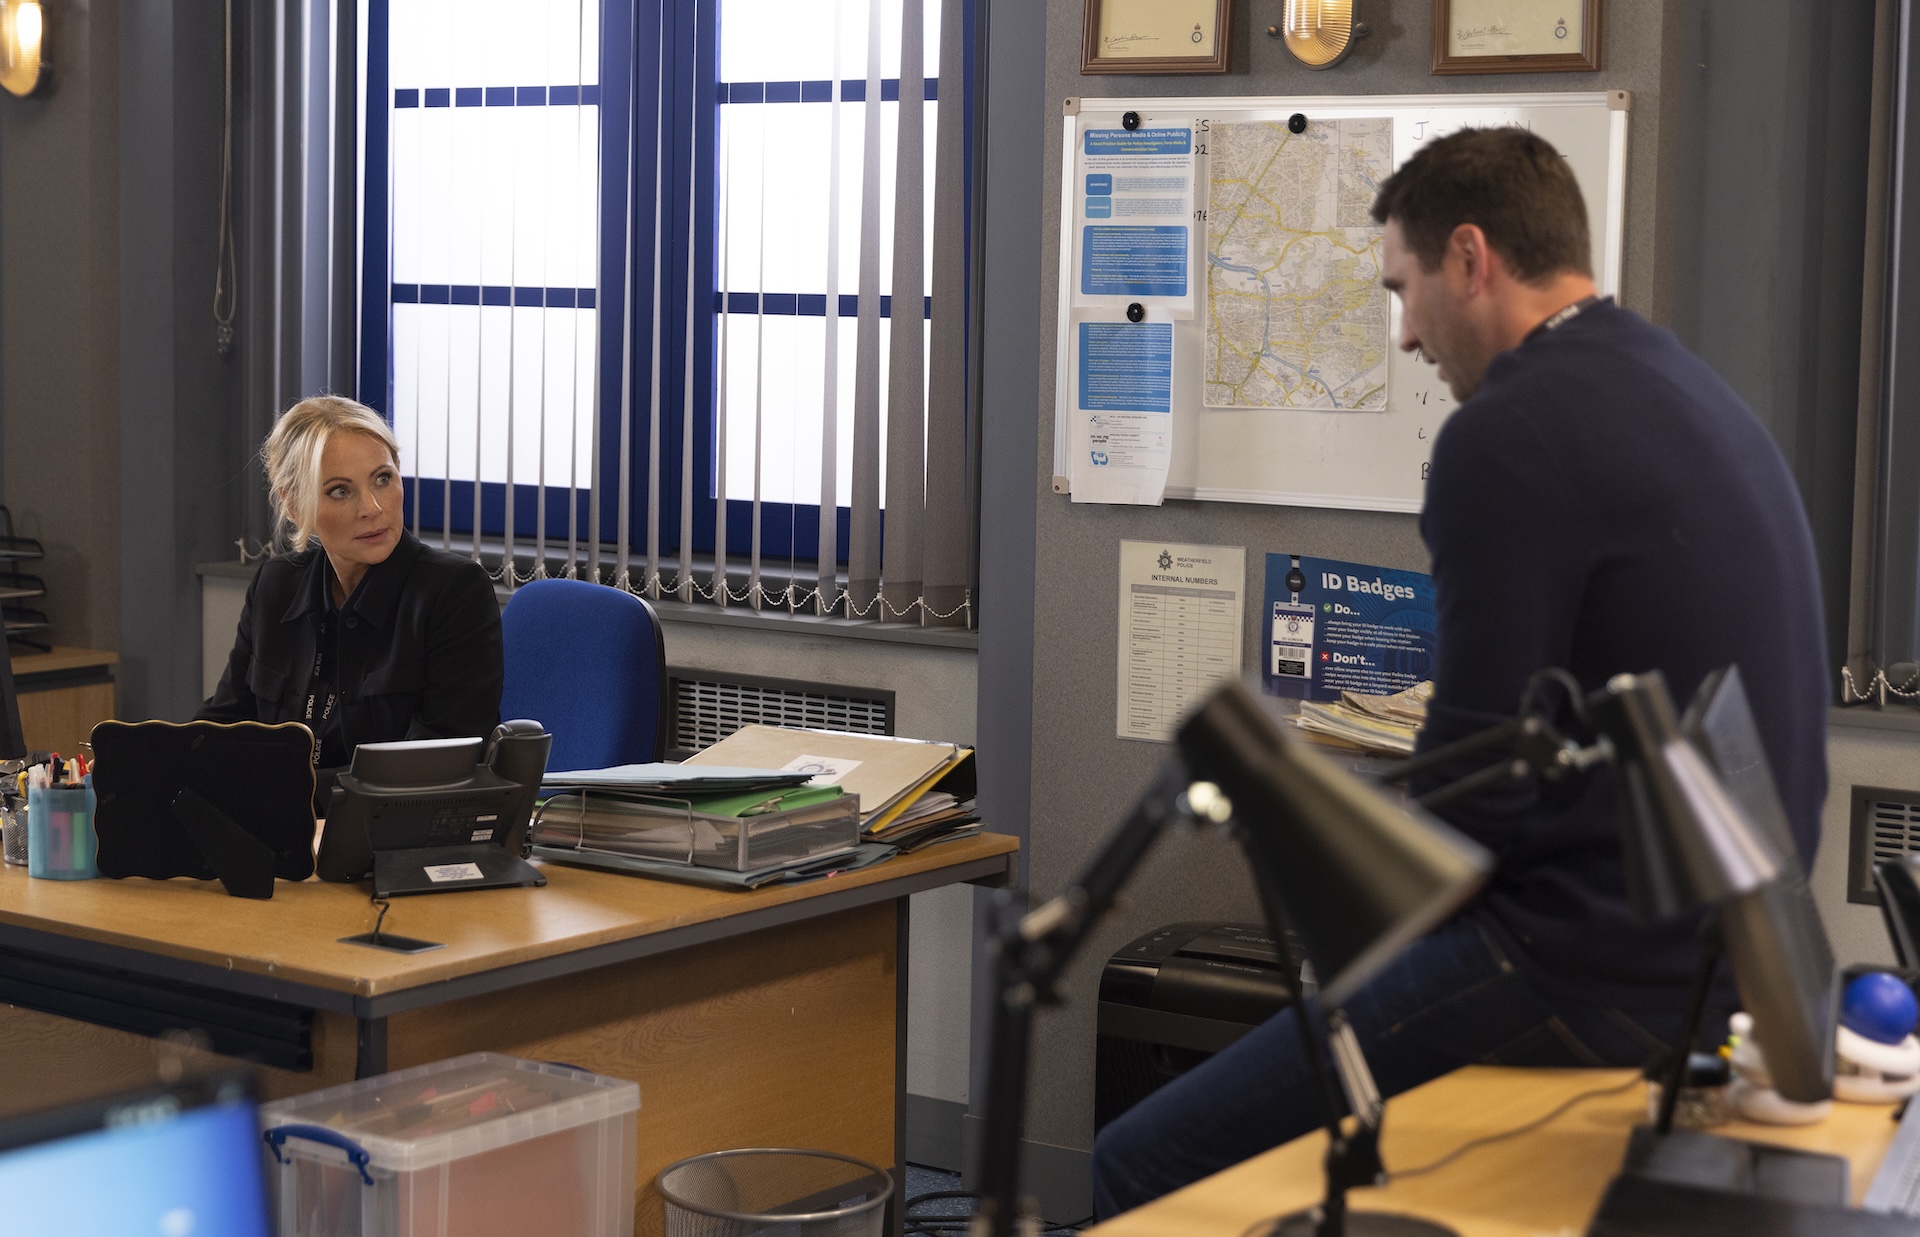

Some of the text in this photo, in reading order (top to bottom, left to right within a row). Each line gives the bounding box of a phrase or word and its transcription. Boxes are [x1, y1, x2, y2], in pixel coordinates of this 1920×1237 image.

[1151, 574, 1218, 585] INTERNAL NUMBERS
[1322, 572, 1415, 602] ID Badges
[1334, 603, 1360, 616] Do...
[1333, 653, 1375, 666] Don't...
[306, 694, 314, 720] POLICE
[322, 694, 336, 720] POLICE
[314, 738, 322, 765] POLICE
